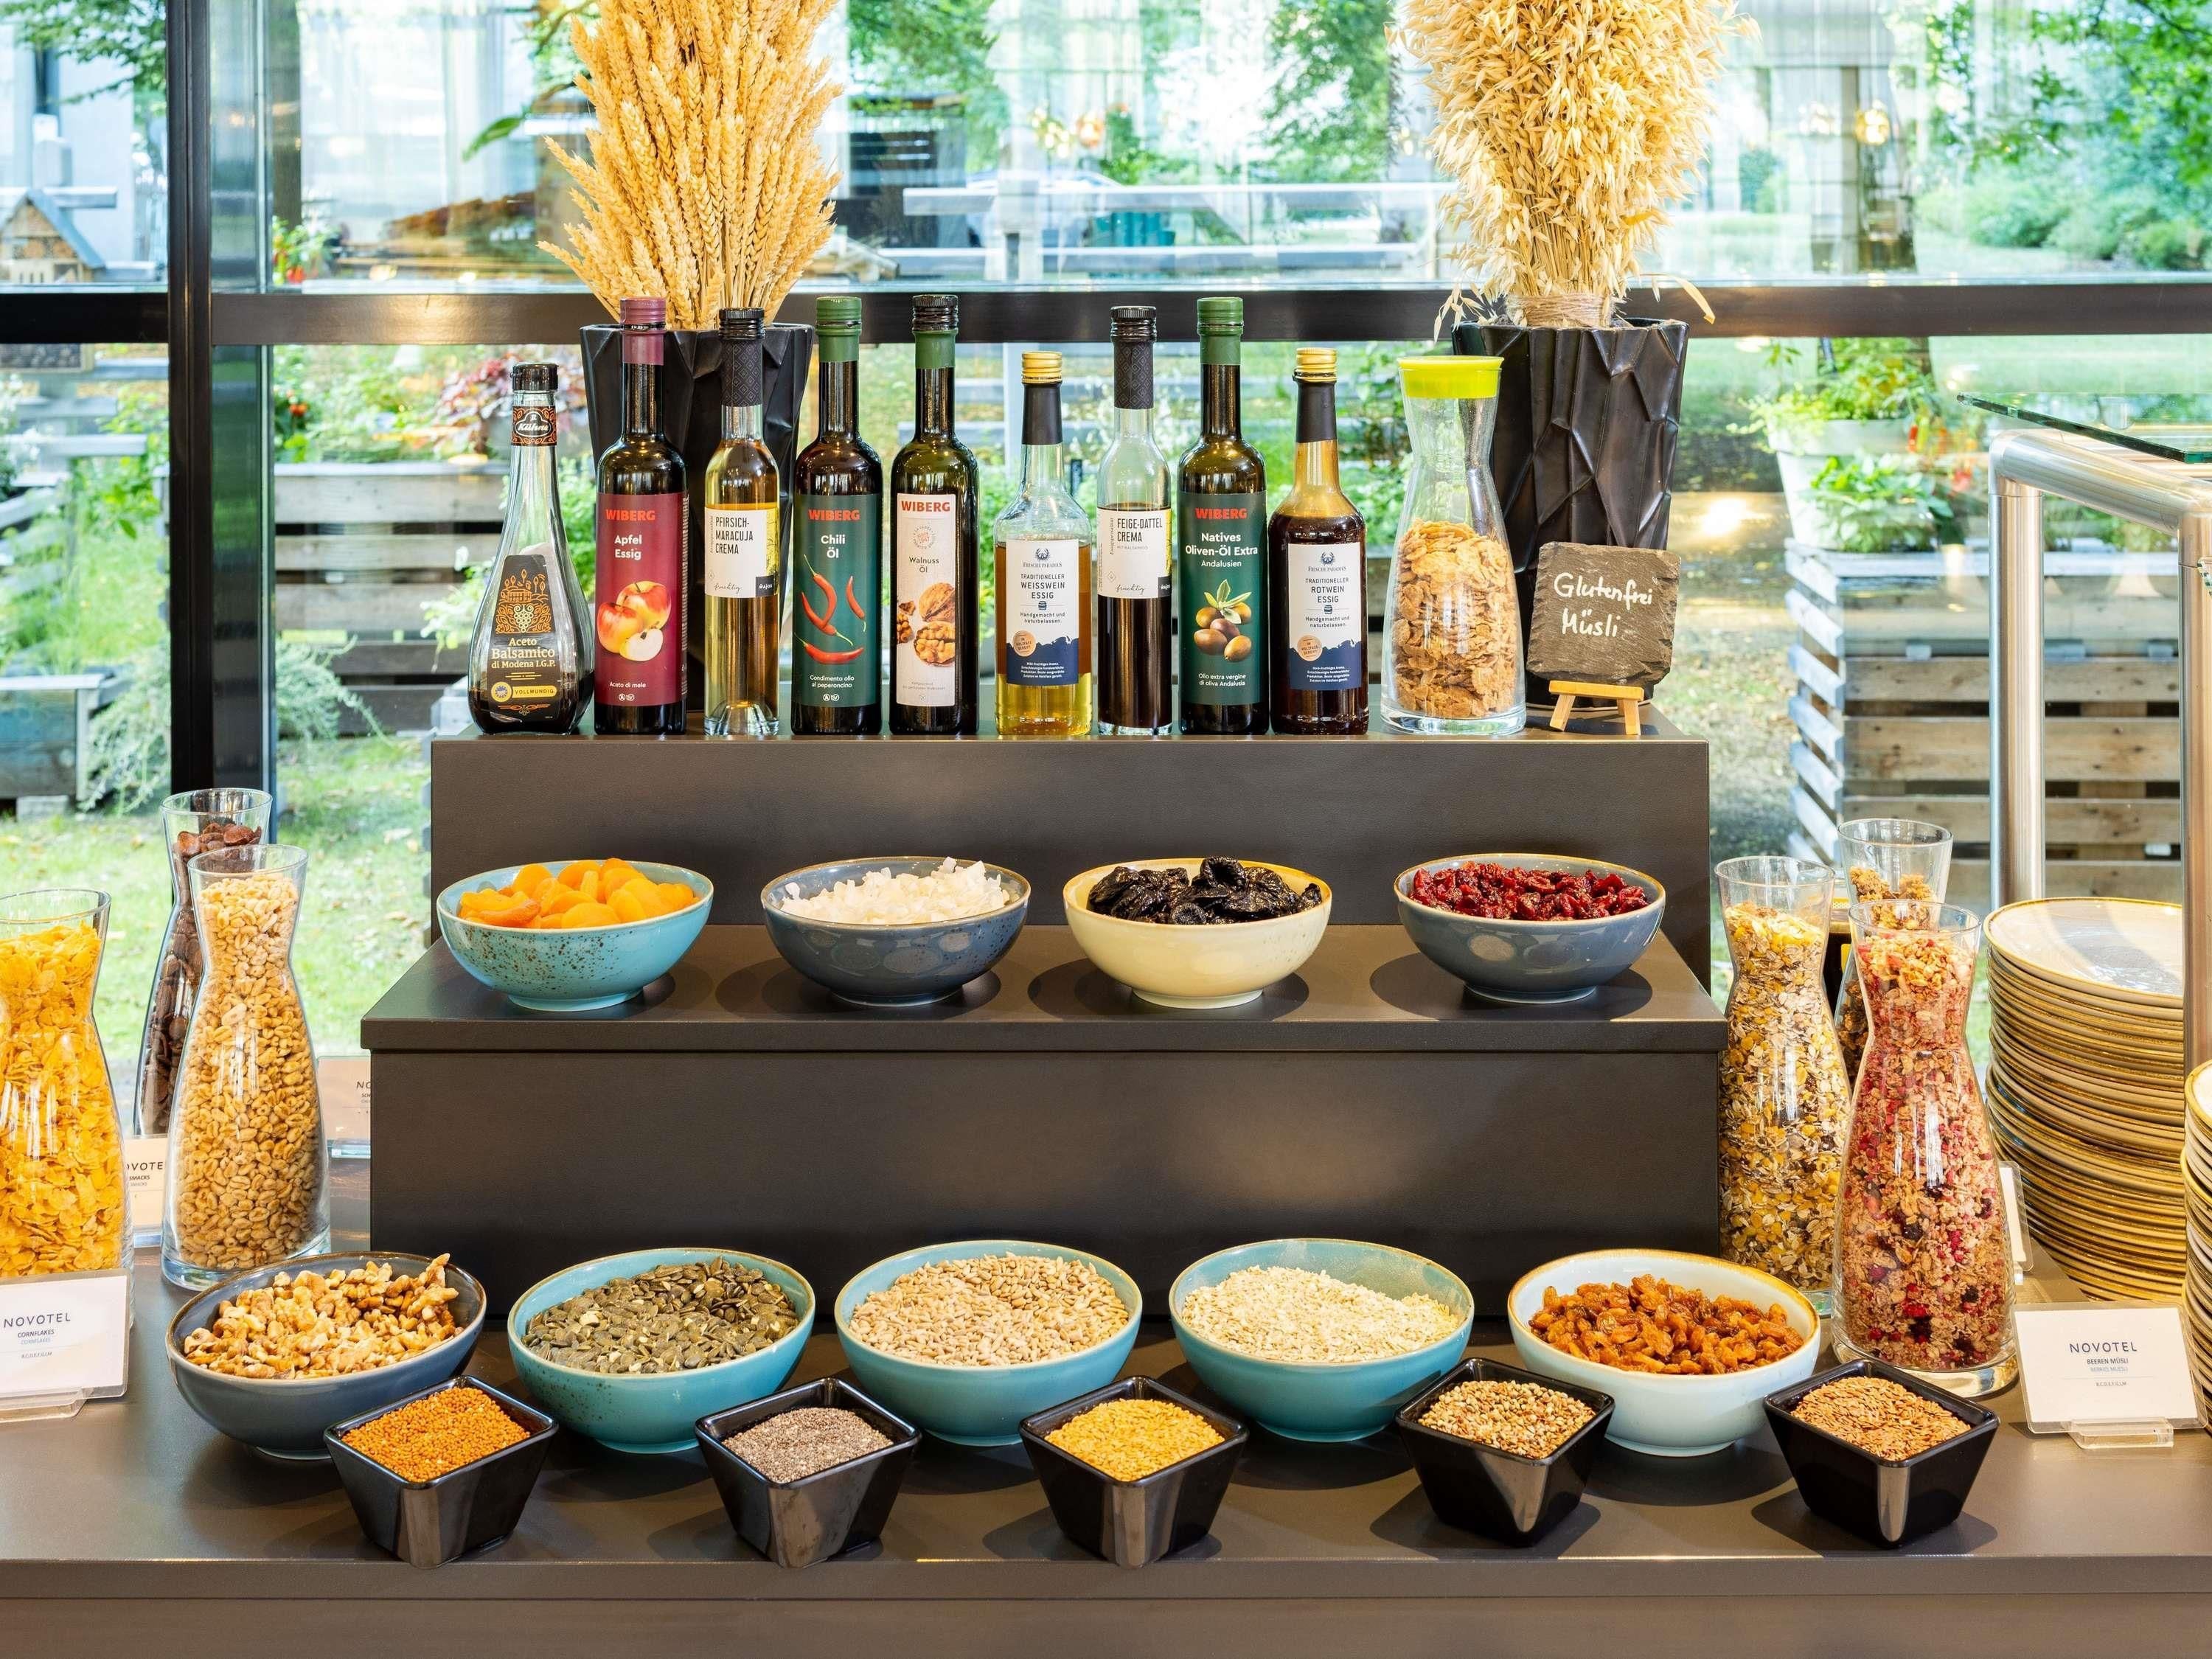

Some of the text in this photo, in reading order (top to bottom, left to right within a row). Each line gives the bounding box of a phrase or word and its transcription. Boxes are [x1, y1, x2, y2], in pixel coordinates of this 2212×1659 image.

[901, 501, 950, 512] WIBERG
[605, 509, 655, 521] WIBERG
[808, 509, 860, 521] WIBERG
[1195, 507, 1247, 519] WIBERG
[715, 517, 750, 528] PFIRSICH-
[1117, 518, 1163, 529] FEIGE-DATTEL
[614, 535, 642, 546] Apfel
[715, 530, 754, 541] MARACUJA
[821, 535, 846, 545] Chili
[1117, 531, 1142, 542] CREMA
[1201, 532, 1241, 542] Natives
[715, 543, 739, 554] CREMA
[827, 547, 839, 559] Öl
[1186, 544, 1258, 556] Oliven-Öl Extra
[615, 549, 642, 560] Essig
[909, 556, 939, 564] Walnuss
[919, 565, 928, 573] Öl
[1554, 572, 1653, 611] Glutenfrei
[1562, 608, 1621, 637] Müsli
[508, 637, 537, 647] Aceto
[491, 647, 555, 659] Balsamico
[491, 659, 555, 669] di Modena I.G.P.
[127, 1161, 164, 1171] VOTE
[4, 1313, 71, 1328] NOVOTEL
[18, 1329, 55, 1338] CORNFLAKES
[2069, 1341, 2138, 1352] NOVOTEL
